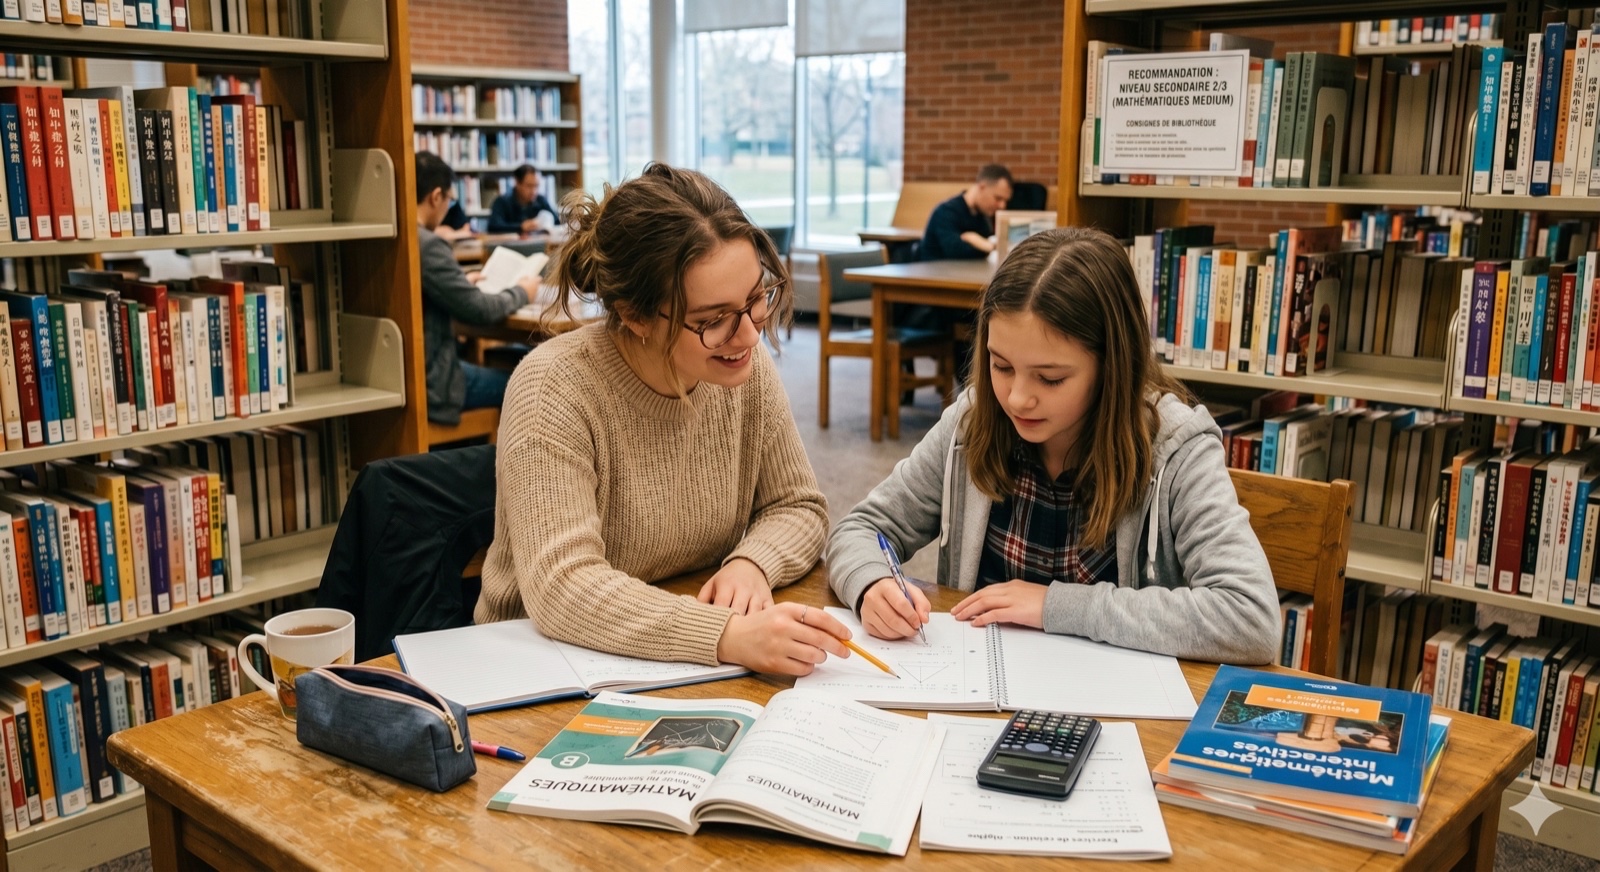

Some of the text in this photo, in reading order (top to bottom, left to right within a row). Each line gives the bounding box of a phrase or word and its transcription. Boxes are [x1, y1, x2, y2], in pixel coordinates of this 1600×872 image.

[1128, 67, 1213, 79] RECOMMANDATION
[1119, 80, 1228, 93] NIVEAU SECONDAIRE 2/3
[1112, 94, 1234, 109] (MATHÉMATIQUES MEDIUM)
[1162, 119, 1170, 127] DE
[559, 755, 581, 767] B
[1233, 741, 1377, 772] interactives
[528, 778, 697, 801] MATHÉMATIQUES
